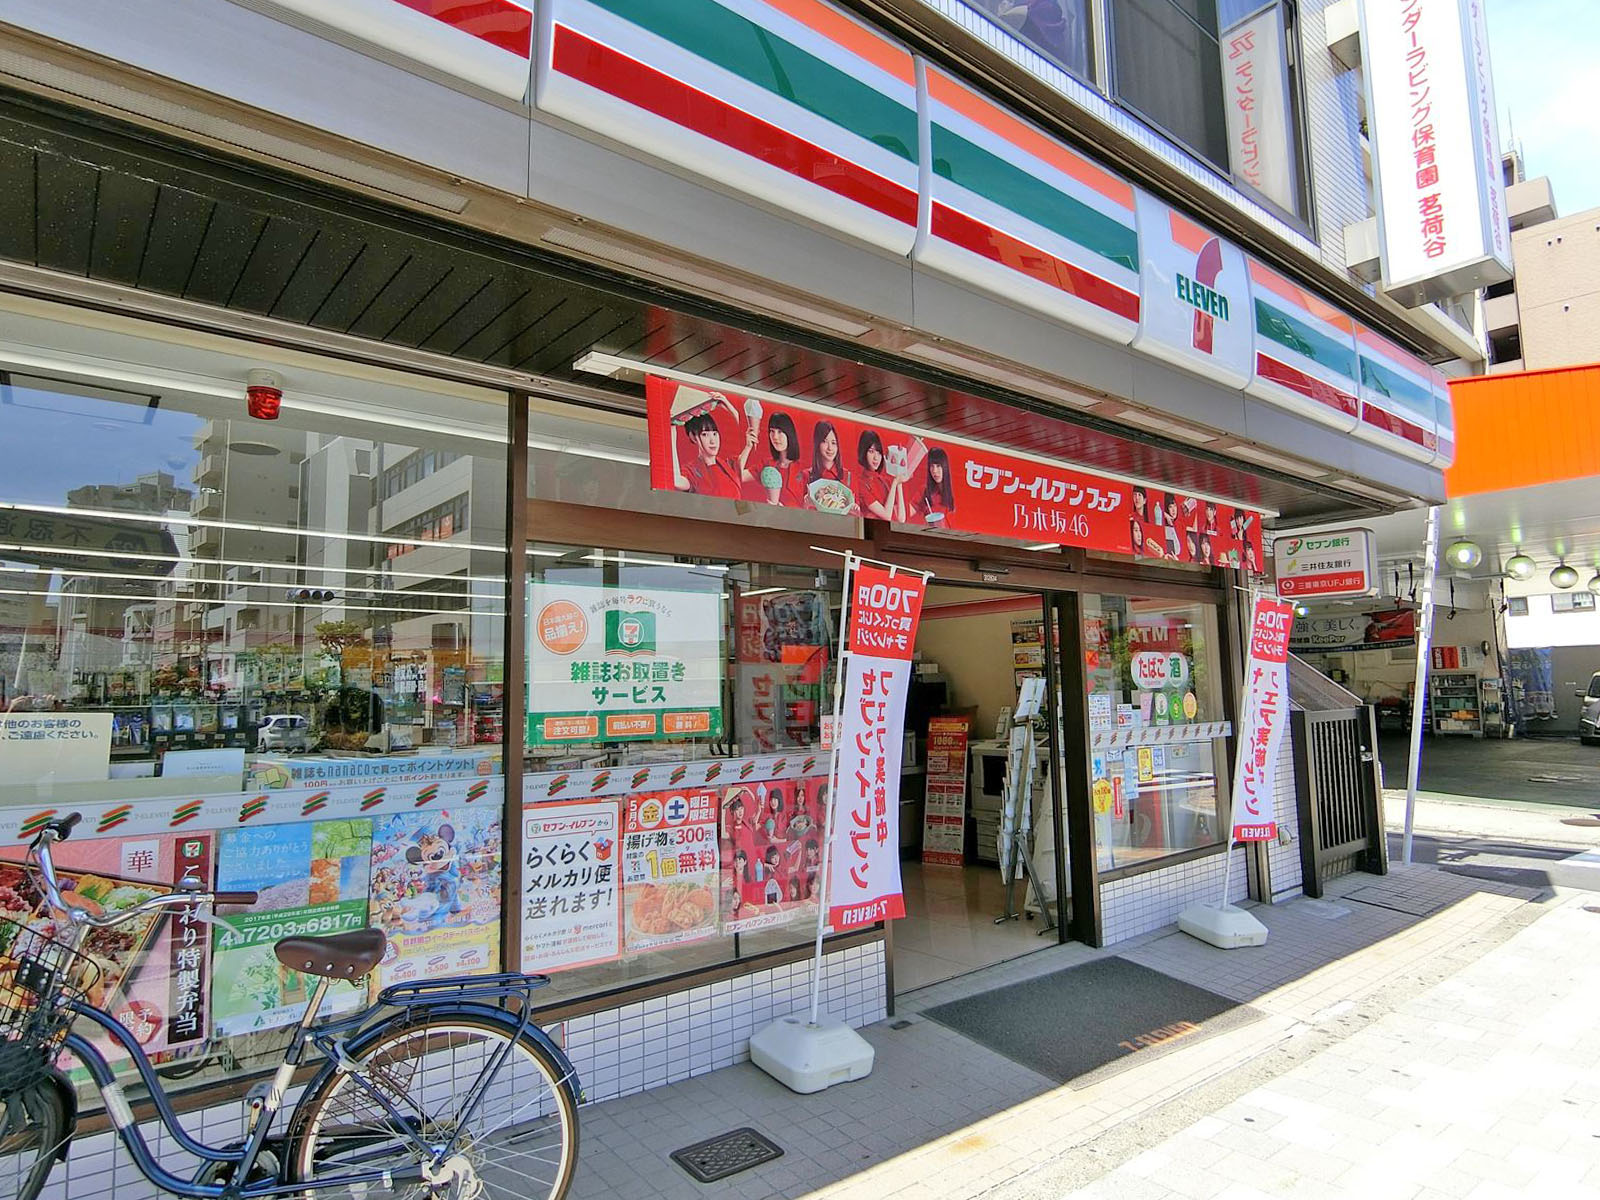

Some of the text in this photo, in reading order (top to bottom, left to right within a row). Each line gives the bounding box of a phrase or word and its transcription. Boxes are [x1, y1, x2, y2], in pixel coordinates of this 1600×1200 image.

[1418, 193, 1446, 259] 茗荷谷
[1013, 503, 1089, 538] 乃木坂46
[1306, 537, 1350, 550] セブン銀行
[1301, 559, 1351, 571] 三井住友銀行
[1298, 577, 1360, 590] 三菱東京UFJ銀行
[570, 661, 686, 683] 雑誌お取置き
[1138, 657, 1166, 679] たばこ
[1169, 657, 1181, 678] 酒
[592, 685, 667, 705] サービス
[0, 719, 81, 729] 他のお客様の
[641, 799, 685, 823] 金 土
[127, 850, 154, 873] 華
[526, 841, 590, 869] らくらく
[526, 864, 612, 893] メルカリ便
[525, 888, 612, 920] 送れます!
[176, 864, 205, 1036] こわり特製弁当
